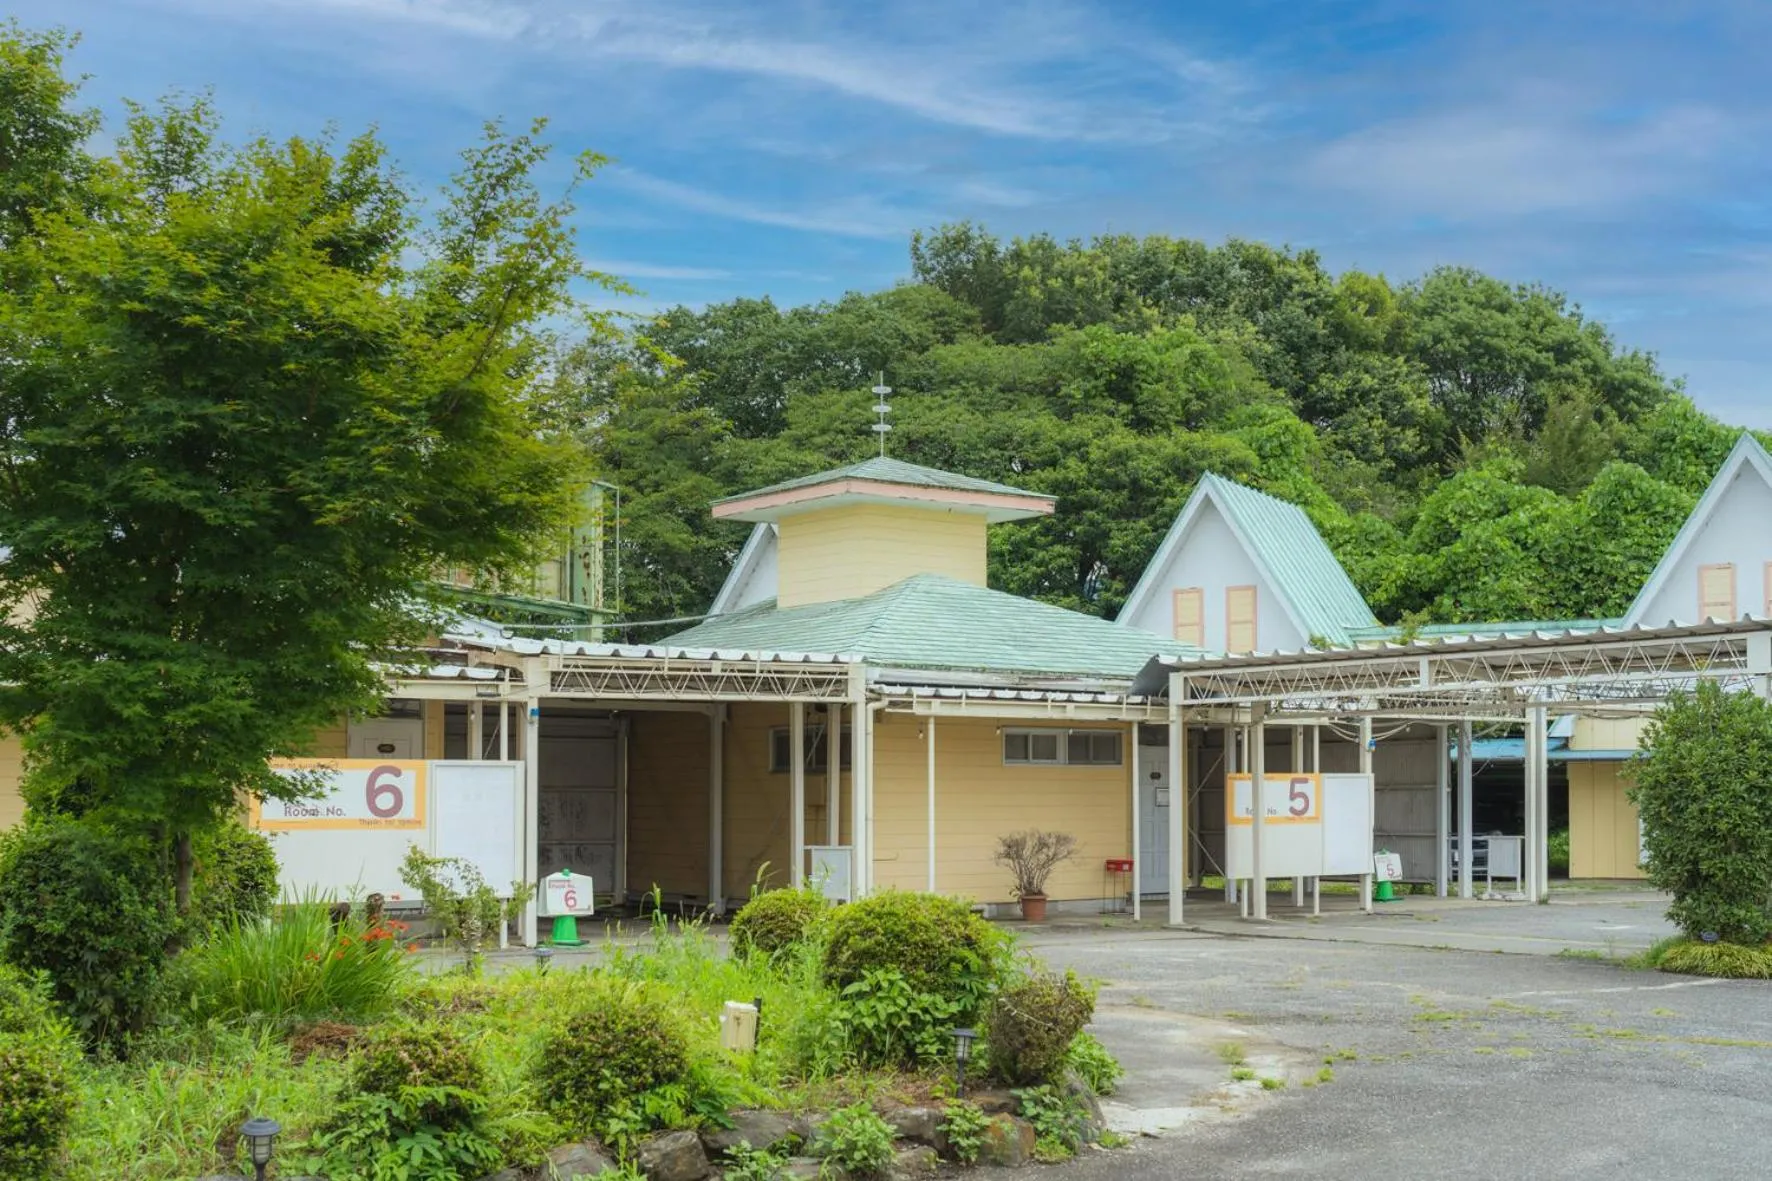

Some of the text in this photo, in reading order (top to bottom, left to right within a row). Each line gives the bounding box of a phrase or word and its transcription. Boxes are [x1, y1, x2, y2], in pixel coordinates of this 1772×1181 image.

[326, 804, 347, 817] No.
[366, 765, 403, 818] 6
[1289, 777, 1310, 816] 5
[564, 889, 577, 908] 6
